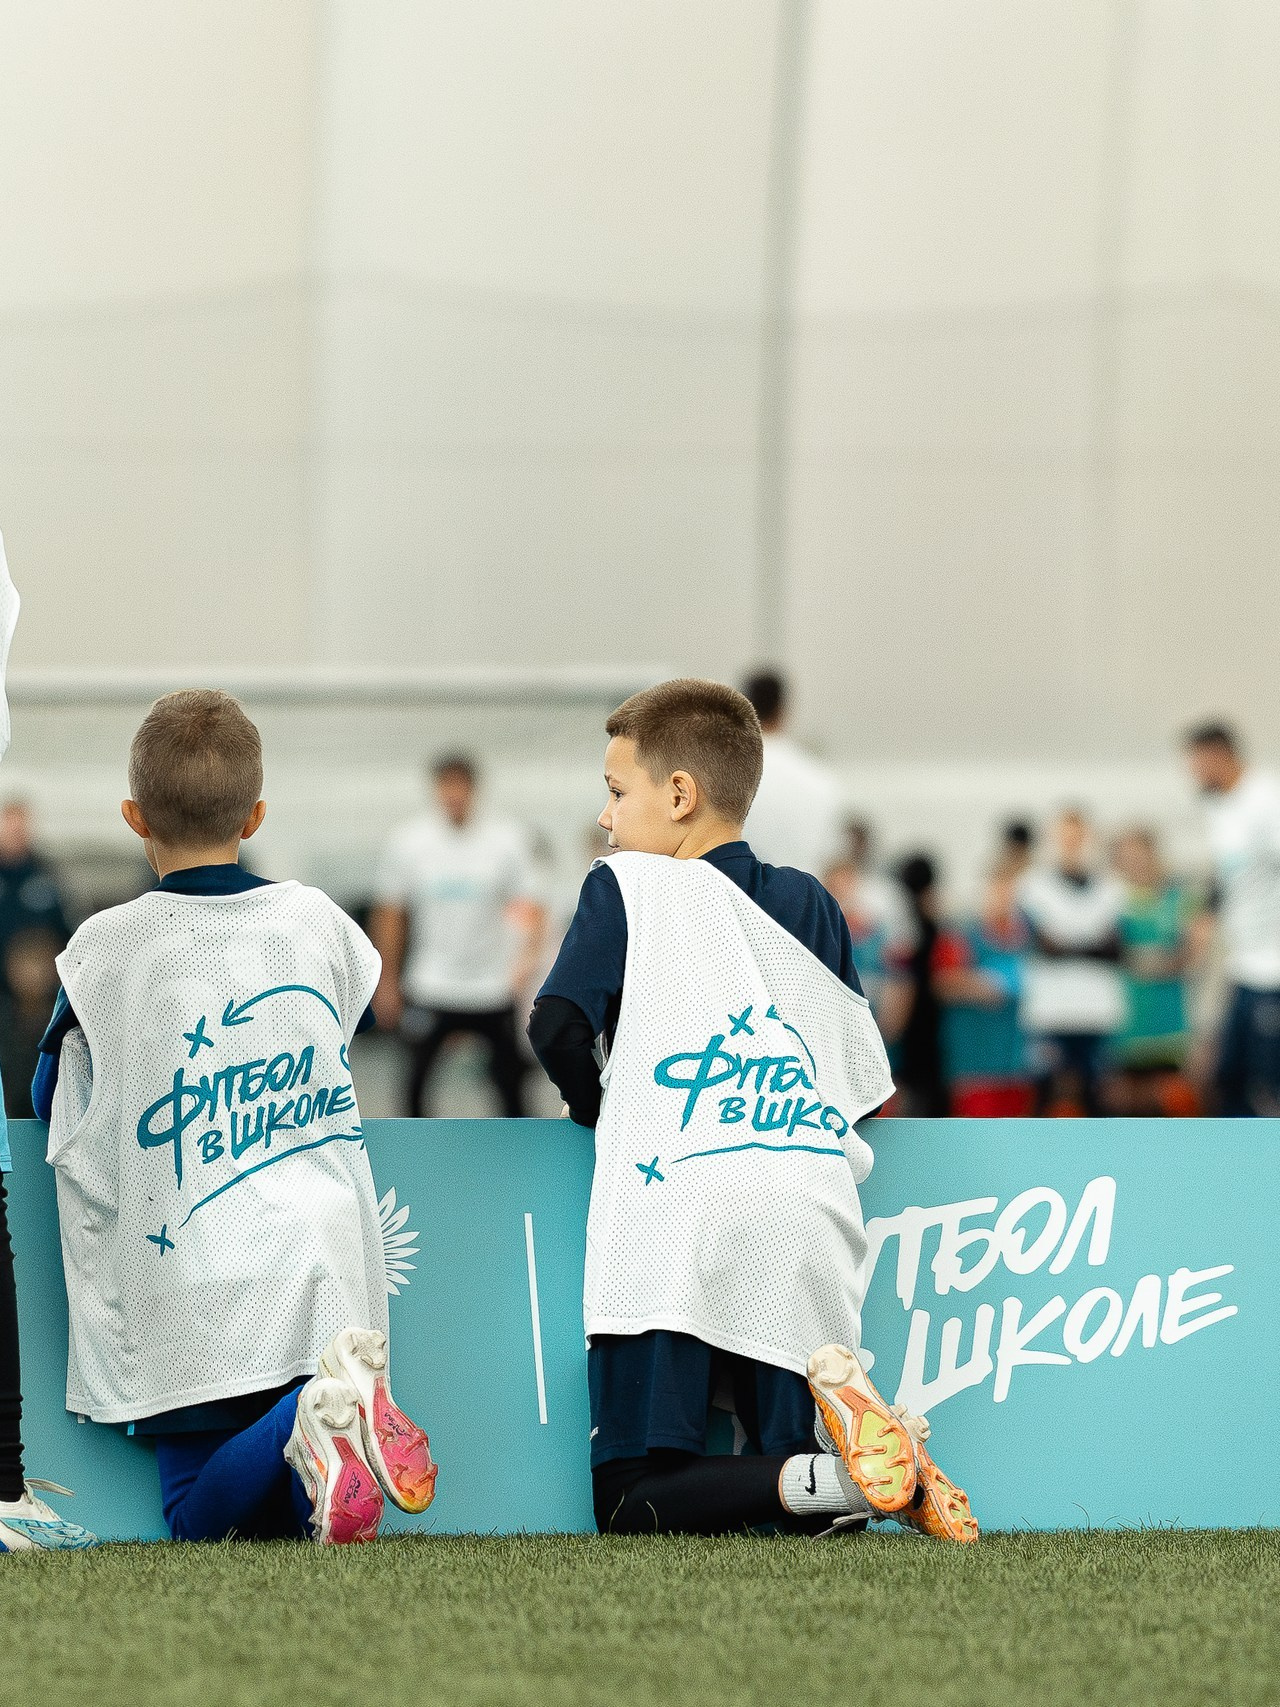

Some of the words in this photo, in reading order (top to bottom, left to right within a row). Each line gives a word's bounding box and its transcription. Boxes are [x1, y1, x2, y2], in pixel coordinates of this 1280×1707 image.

[136, 1045, 315, 1190] ФУТБОЛ
[197, 1129, 224, 1164] В
[230, 1083, 356, 1160] ШКОЛЕ
[719, 1096, 746, 1124] В
[894, 1264, 1239, 1416] ШКОЛЕ
